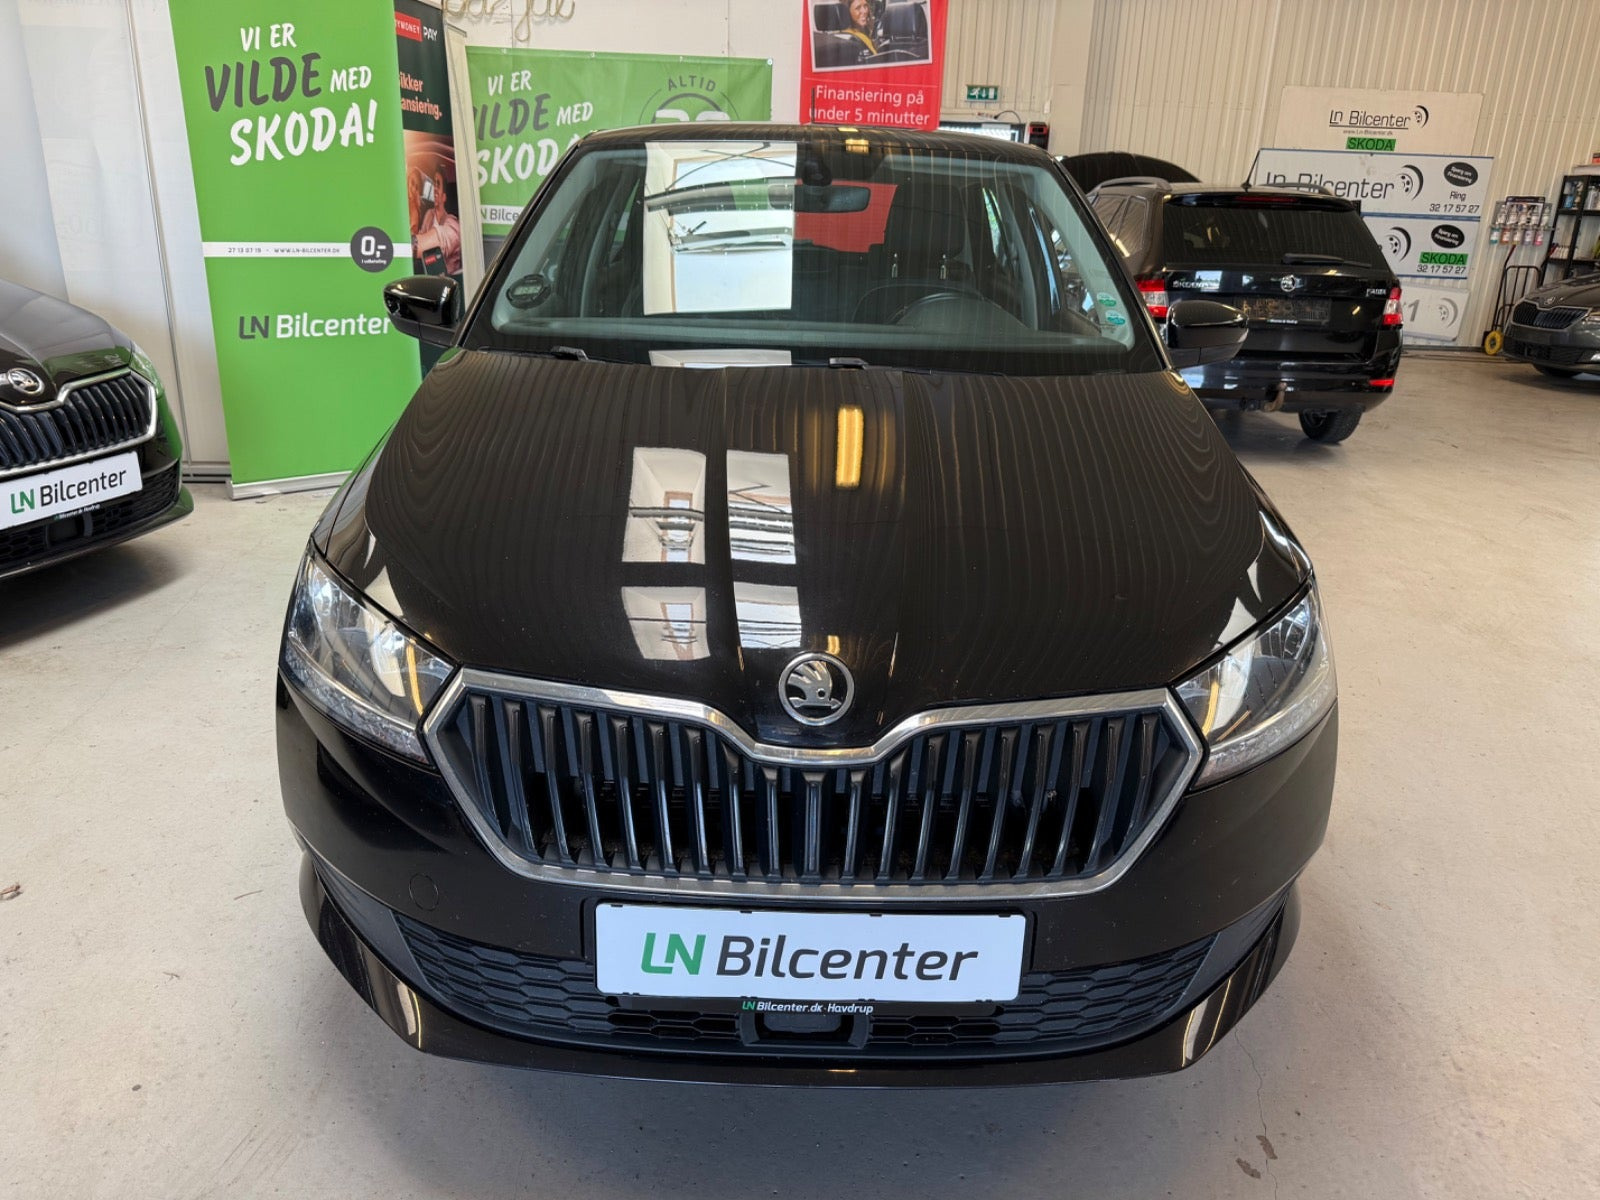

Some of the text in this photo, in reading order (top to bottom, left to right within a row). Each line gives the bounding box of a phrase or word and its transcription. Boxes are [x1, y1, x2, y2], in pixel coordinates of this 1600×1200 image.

[240, 22, 297, 52] VI ER
[396, 20, 438, 41] YMONEY PAY
[204, 52, 372, 112] VILDE MED
[400, 72, 424, 92] ikker
[487, 69, 532, 97] VI ER
[668, 75, 716, 92] ALTID
[816, 85, 924, 107] Finansiering på
[401, 96, 443, 120] ansiering.
[556, 102, 594, 126] MED
[809, 105, 930, 125] under 5 minutter
[1349, 110, 1411, 127] Bilcenter
[230, 99, 378, 166] SKODA!
[1347, 137, 1394, 150] SKODA
[477, 133, 581, 188] SKOD
[1450, 191, 1467, 202] Ring
[489, 208, 520, 222] Bilce
[1429, 203, 1480, 214] 32 17 57 27
[1416, 264, 1429, 273] 32
[1430, 265, 1442, 274] 17
[1455, 266, 1467, 275] 27
[1421, 252, 1466, 266] SKODA
[239, 311, 391, 340] LN Bilcenter
[10, 469, 127, 515] LN Bilcenter
[640, 932, 979, 982] LN Bilcenter
[742, 1001, 874, 1016] LN Bilcenter.dk Havdrup
